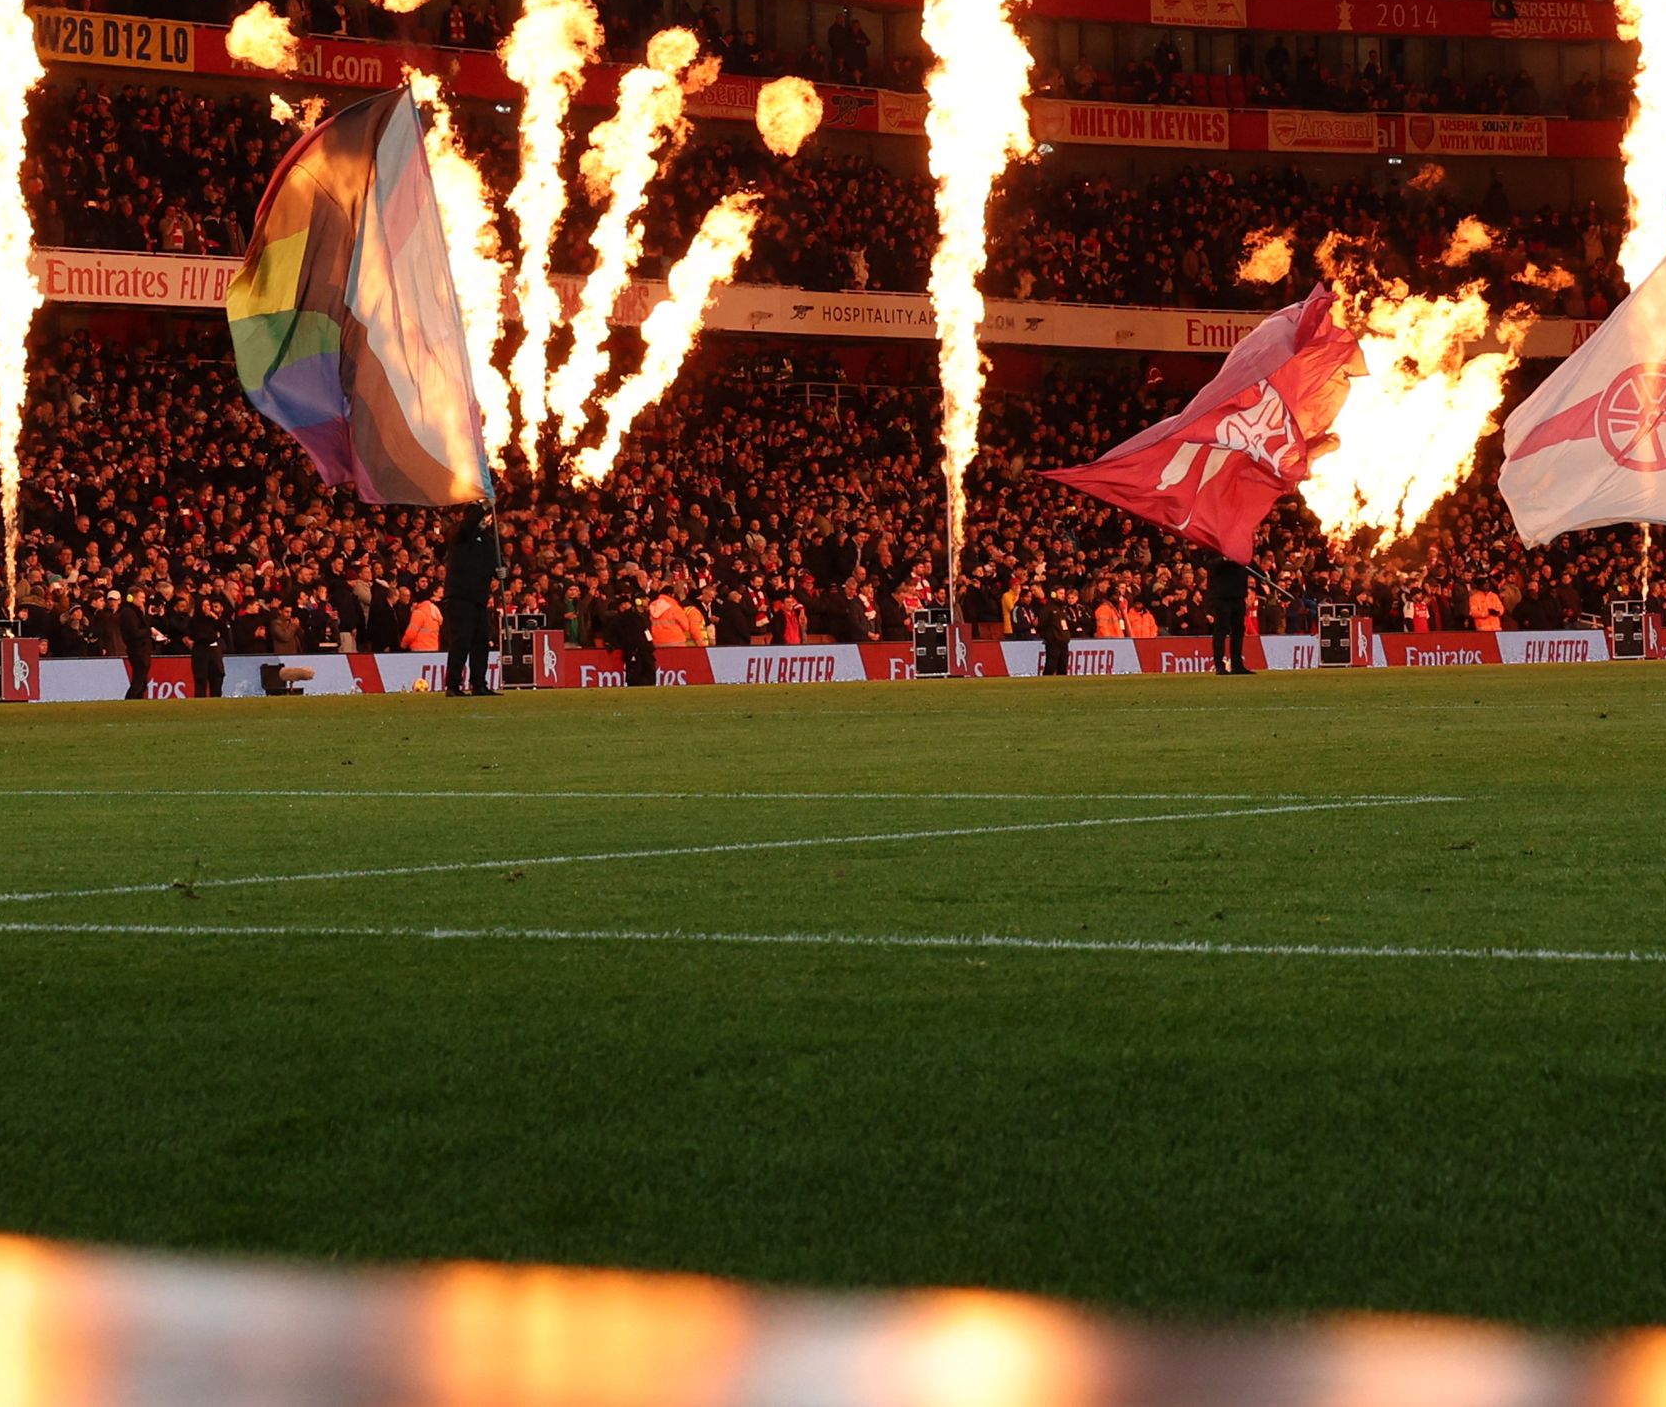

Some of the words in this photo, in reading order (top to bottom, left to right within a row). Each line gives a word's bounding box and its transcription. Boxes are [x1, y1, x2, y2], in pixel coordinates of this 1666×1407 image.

[1376, 4, 1437, 29] 2014
[1521, 1, 1589, 19] ARSENAL
[37, 14, 93, 55] W26
[103, 20, 151, 61] D12
[1513, 17, 1594, 35] MALAYSIA
[705, 80, 754, 108] senal
[1070, 107, 1145, 139] MILTON
[1151, 111, 1225, 143] KEYNES
[1296, 114, 1374, 139] Arsenal
[1439, 119, 1479, 132] ARSENAL
[1482, 120, 1509, 132] SOUTH
[1439, 135, 1469, 150] WITH
[1472, 135, 1494, 150] YOU
[1498, 135, 1543, 151] ALWAYS
[46, 259, 168, 298] Emirates
[181, 266, 209, 300] FLY
[1293, 646, 1314, 670] FLY
[1406, 645, 1483, 666] Emirates
[1525, 641, 1545, 664] FLY
[1548, 640, 1589, 664] BETTER
[747, 658, 773, 684] FLY
[777, 656, 834, 683] BETTER
